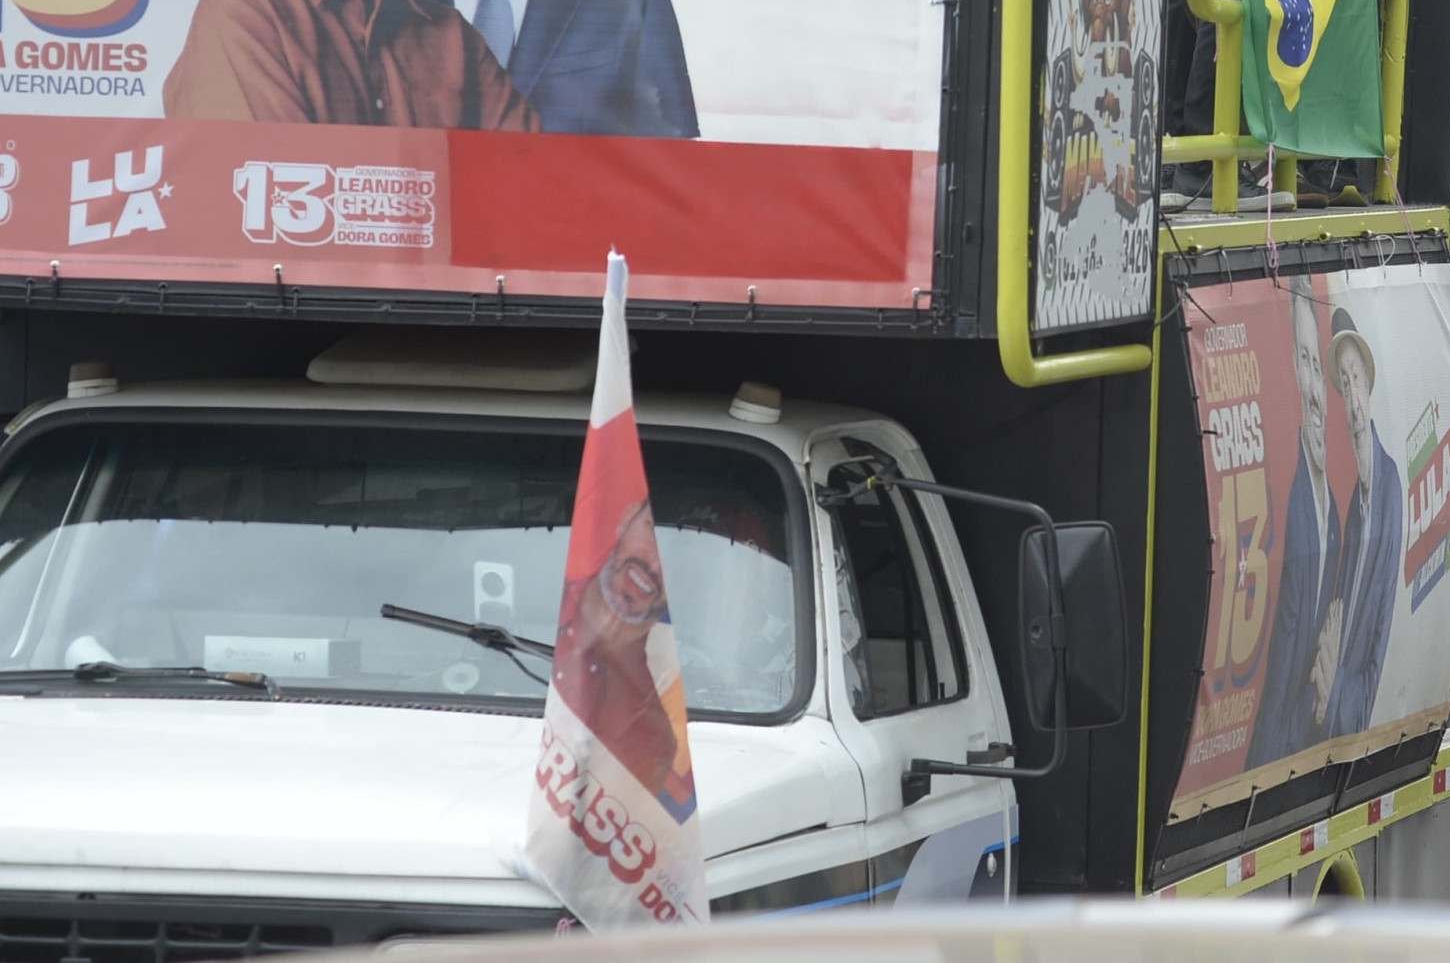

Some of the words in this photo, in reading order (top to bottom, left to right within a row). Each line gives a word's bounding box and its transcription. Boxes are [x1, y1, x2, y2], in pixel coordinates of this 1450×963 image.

[14, 40, 148, 72] GOMES
[234, 162, 333, 242] 13
[338, 177, 433, 196] LEANDRO
[337, 195, 434, 223] GRASS
[337, 231, 376, 243] DORA
[379, 232, 432, 246] GOMES
[1205, 323, 1248, 353] GOVERNADOR
[1202, 349, 1260, 403] LEANDRO
[1209, 400, 1265, 472] GRASS
[1213, 467, 1270, 671] 13
[536, 725, 656, 884] RASS
